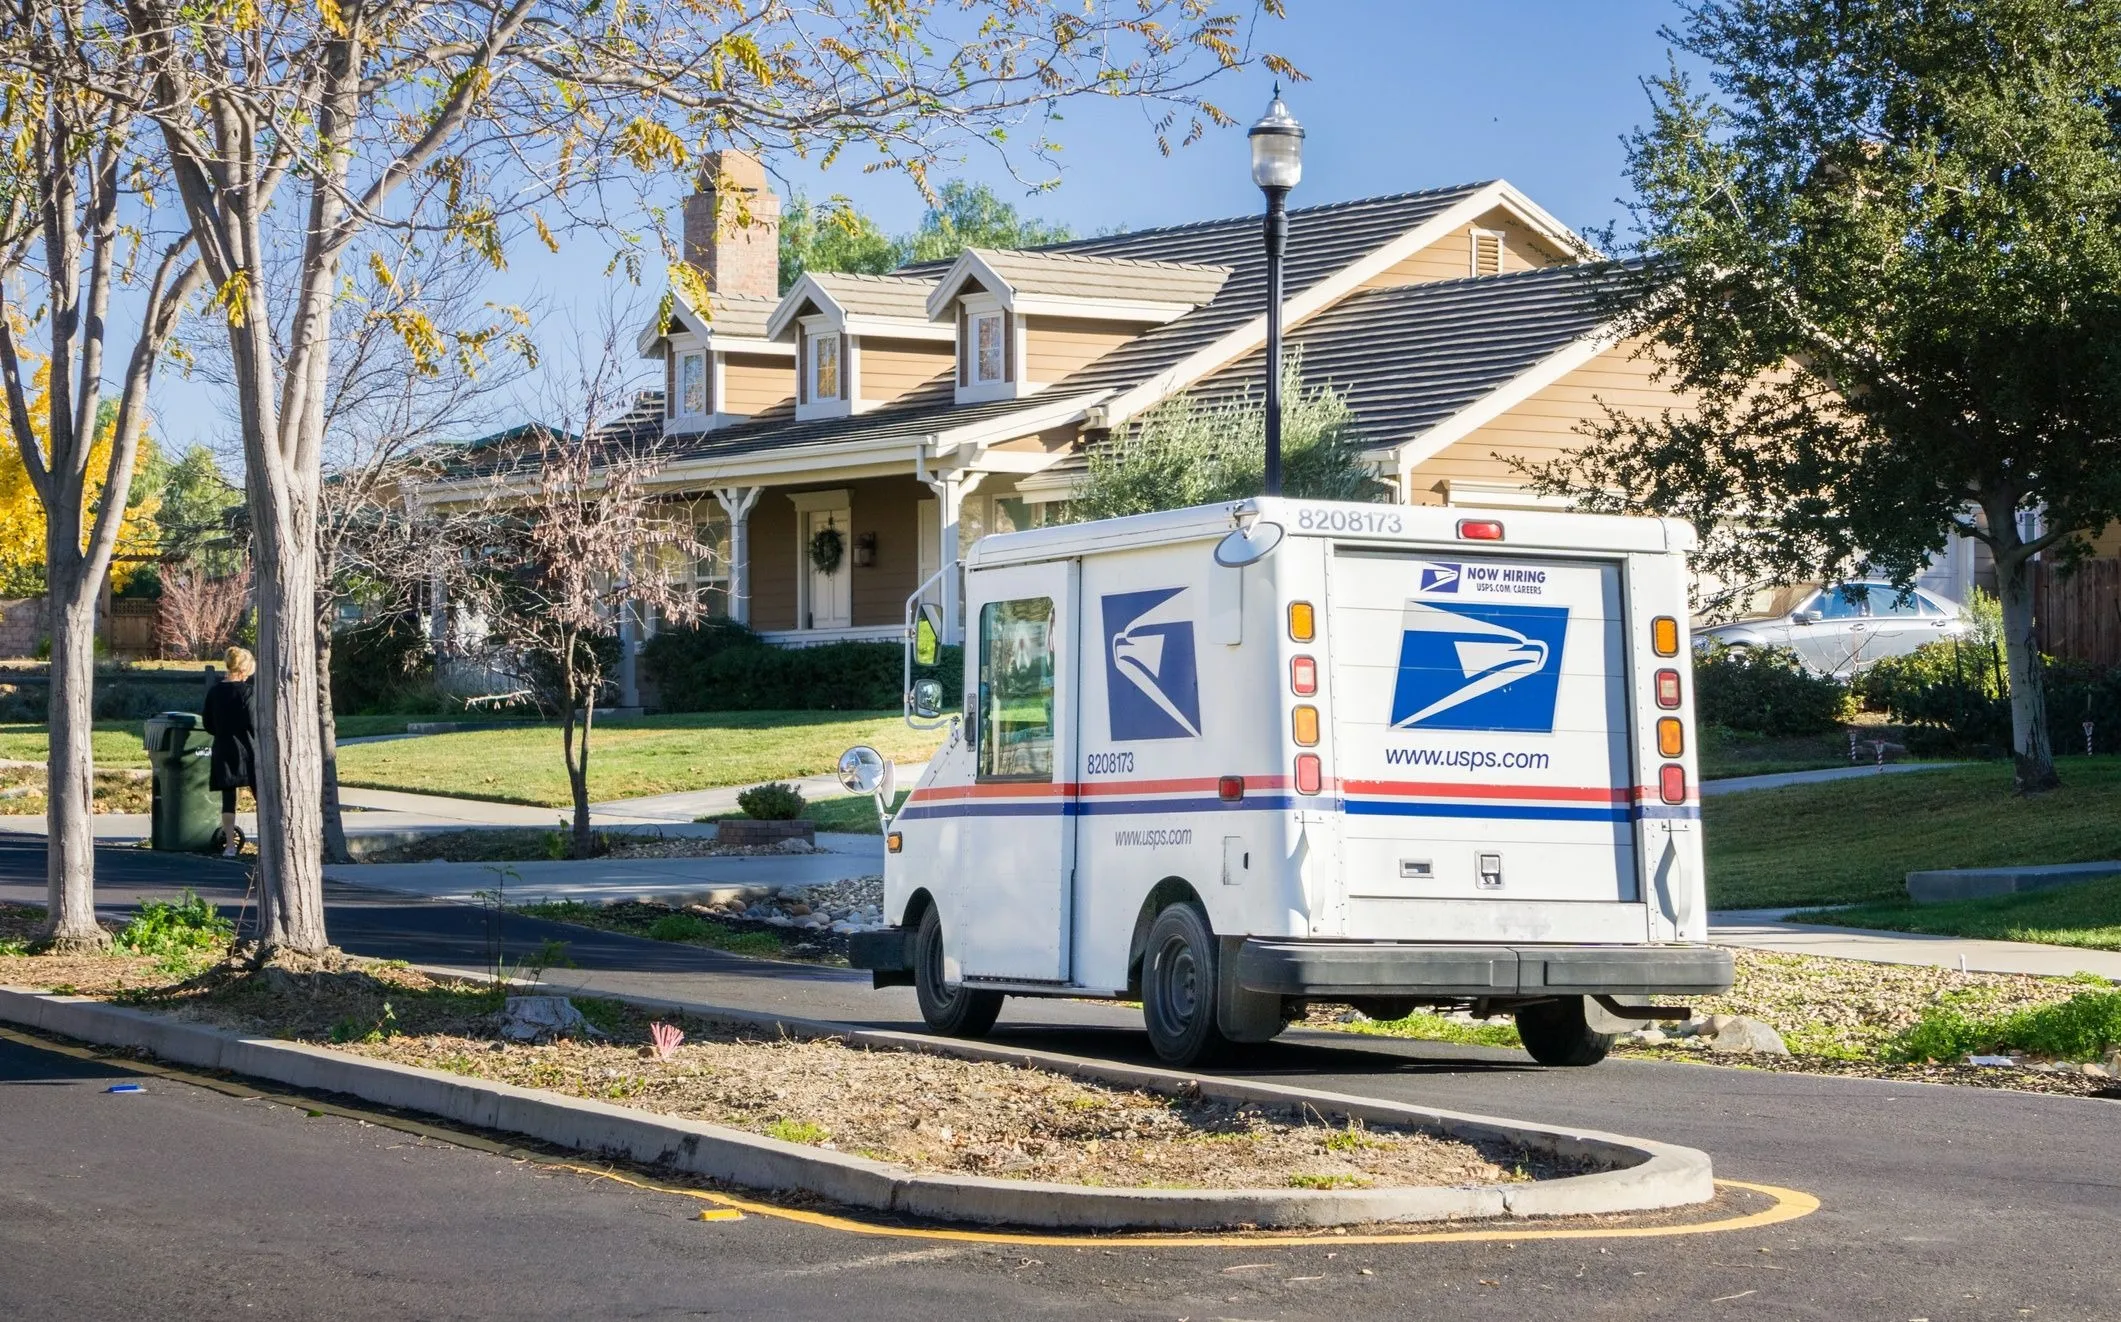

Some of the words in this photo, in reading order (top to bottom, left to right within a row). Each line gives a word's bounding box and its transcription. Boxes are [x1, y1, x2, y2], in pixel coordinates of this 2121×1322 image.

[1298, 508, 1402, 533] 8208173
[1467, 567, 1499, 581] NOW
[1503, 569, 1546, 583] HIRING
[1476, 583, 1511, 593] USPS.COM
[1513, 584, 1541, 595] CAREERS
[1087, 752, 1134, 775] 8208173
[1385, 748, 1549, 772] www.usps.com
[1115, 829, 1192, 851] www.usps.com
